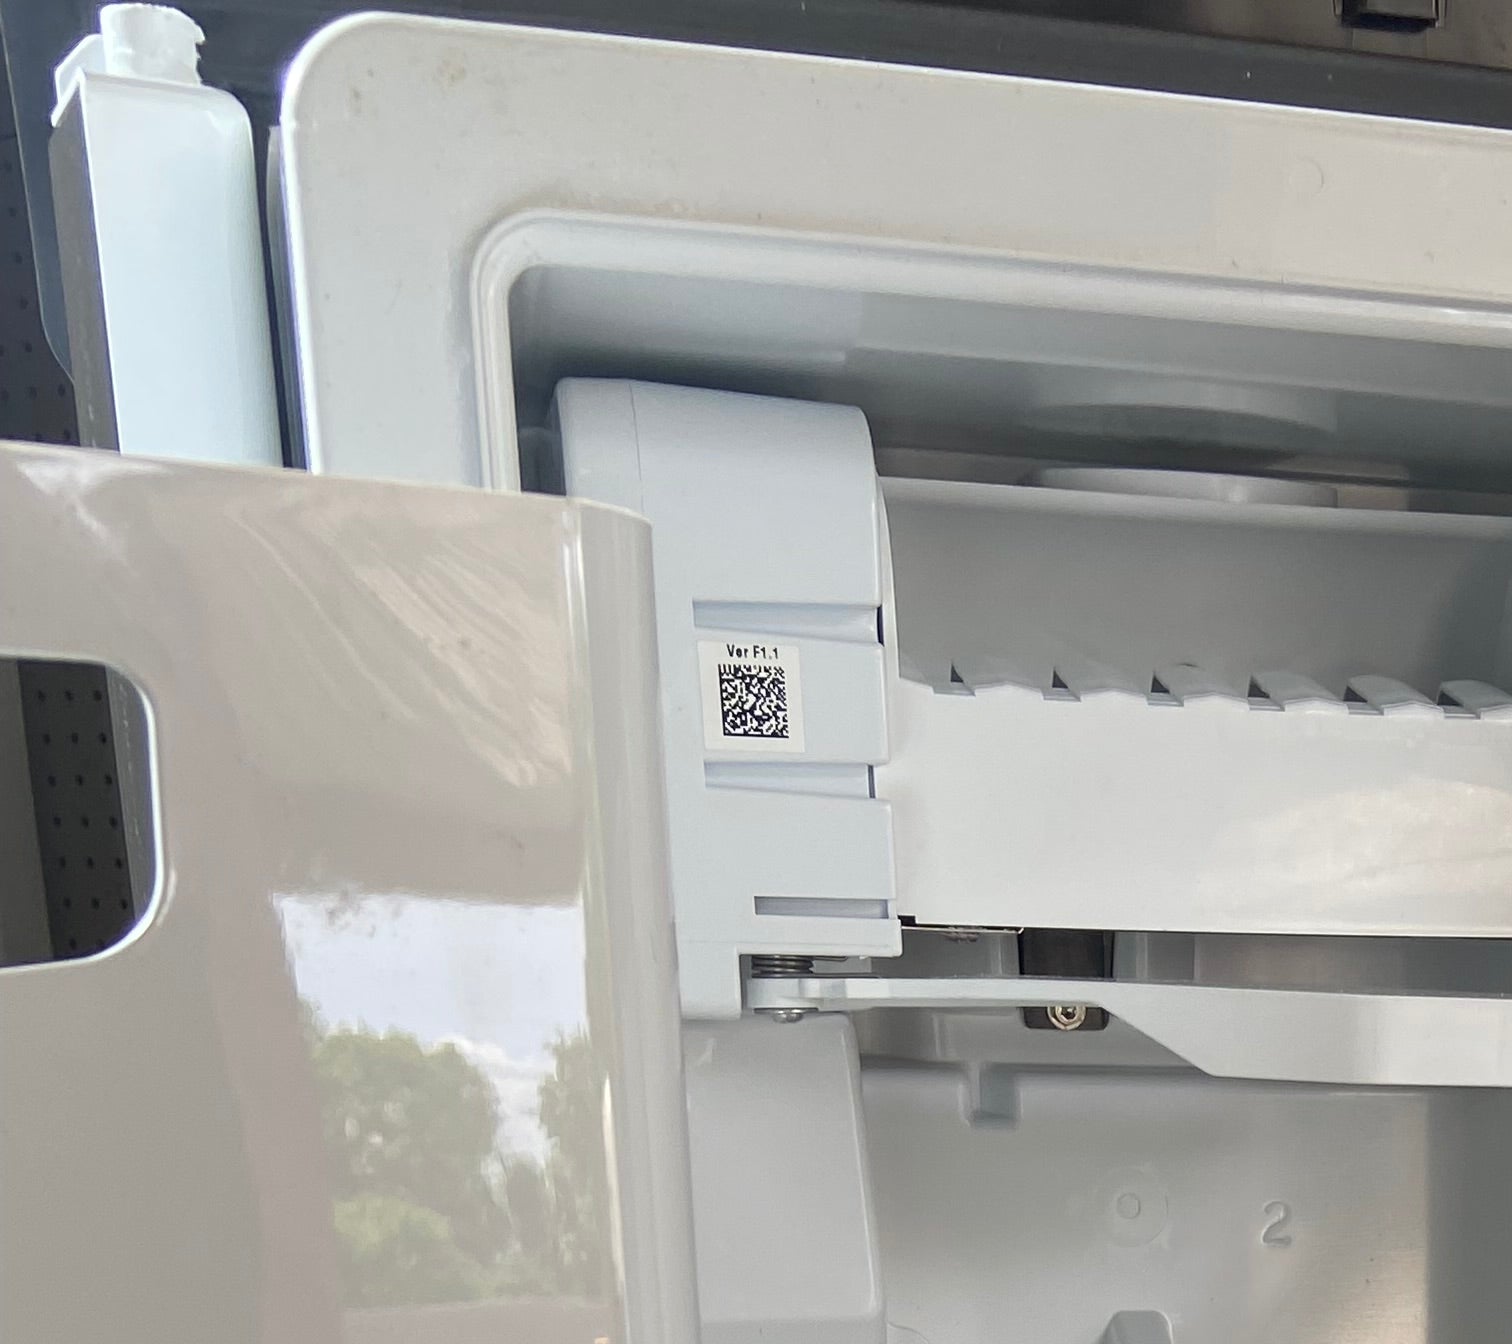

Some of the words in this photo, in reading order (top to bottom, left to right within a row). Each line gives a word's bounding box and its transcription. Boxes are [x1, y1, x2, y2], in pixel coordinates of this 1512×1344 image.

[726, 643, 749, 658] Ver
[753, 644, 778, 660] F1.1
[1261, 1200, 1293, 1247] 2
